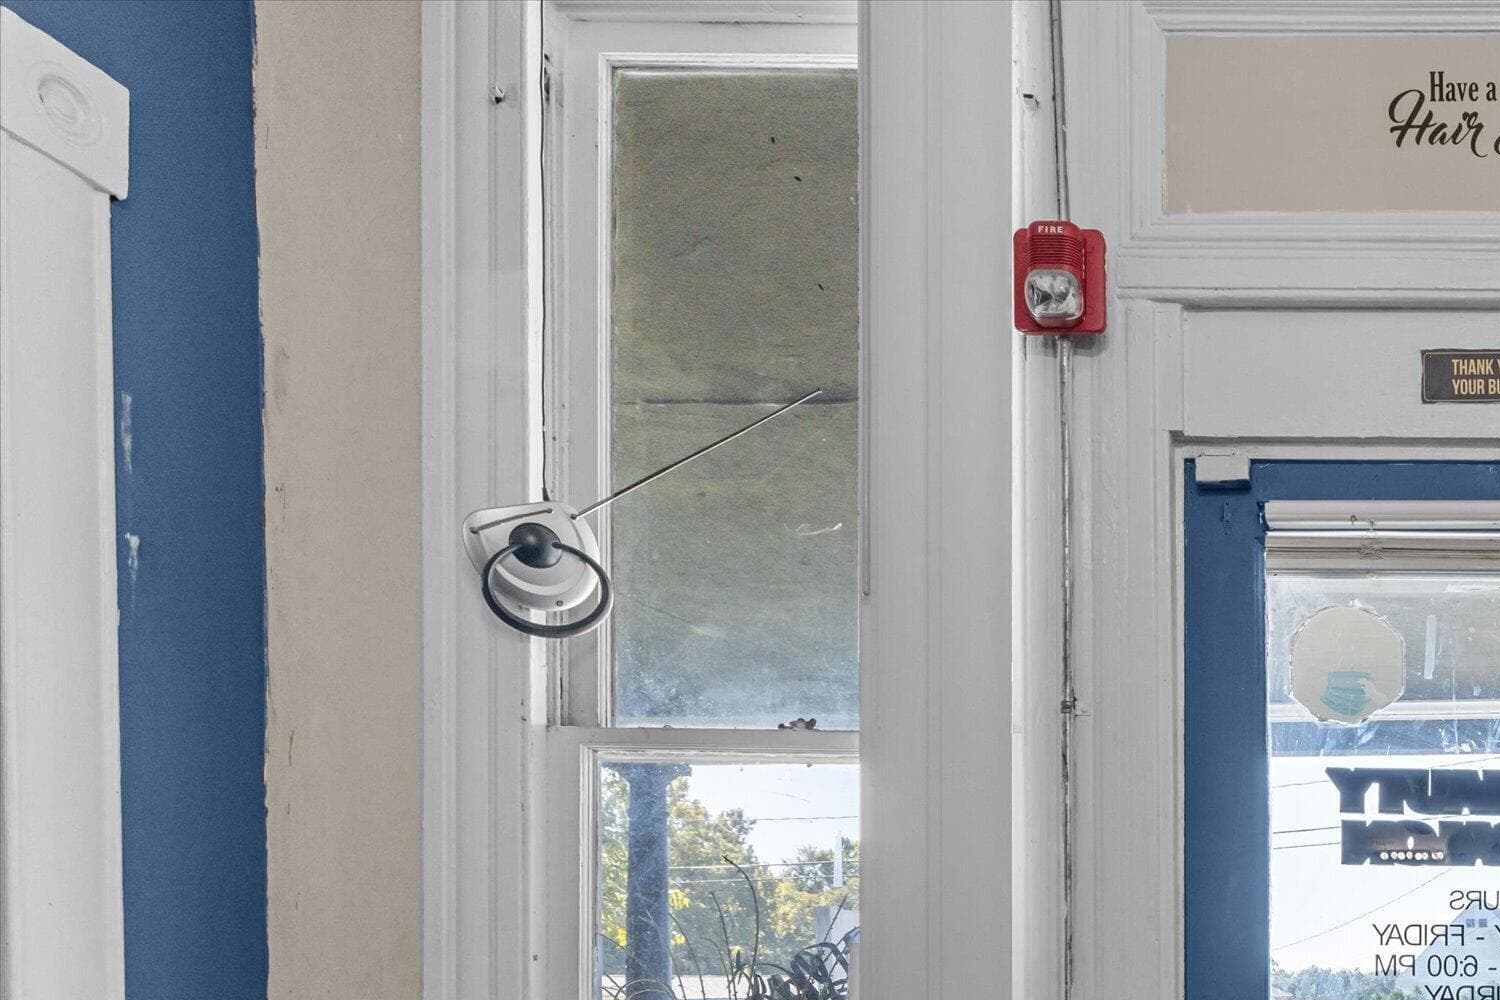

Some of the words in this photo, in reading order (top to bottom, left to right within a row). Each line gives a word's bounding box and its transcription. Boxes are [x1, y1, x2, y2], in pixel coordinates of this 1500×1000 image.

[1429, 71, 1479, 102] Have
[1486, 81, 1497, 102] a
[1388, 89, 1488, 158] Hair
[1452, 359, 1494, 375] THANK
[1452, 379, 1485, 395] YOUR
